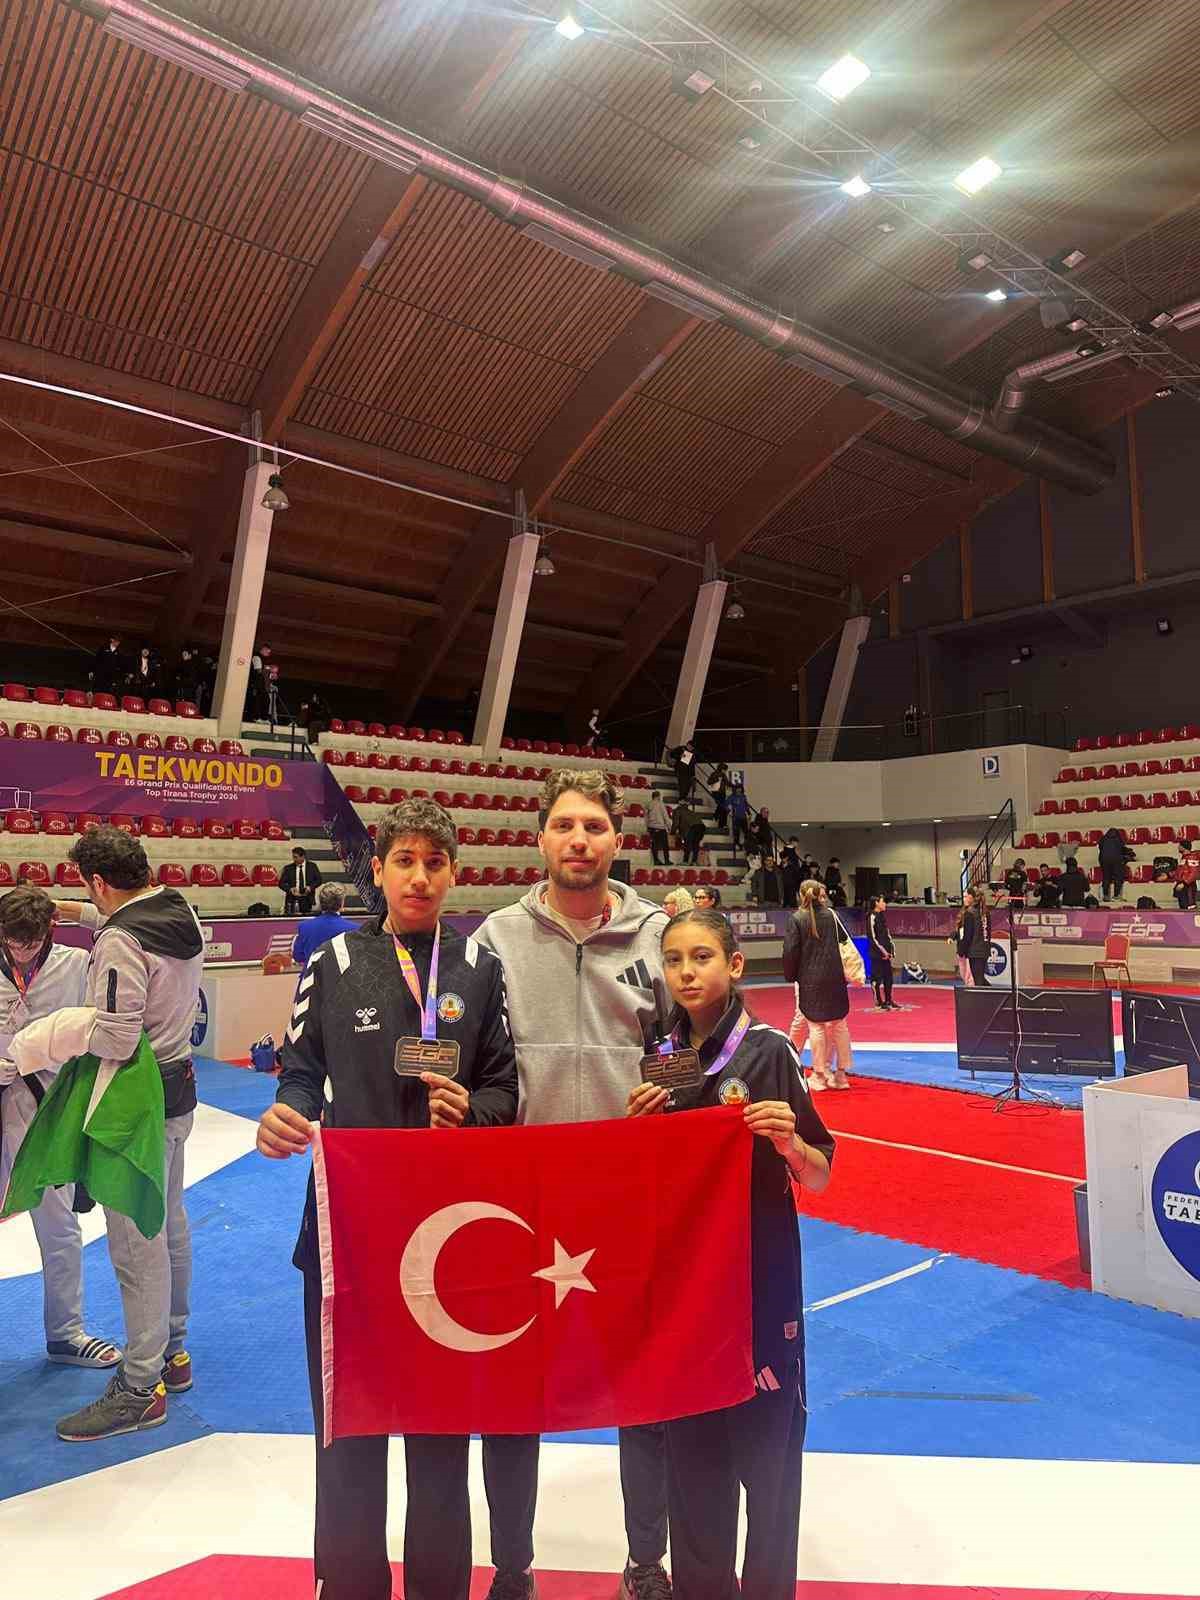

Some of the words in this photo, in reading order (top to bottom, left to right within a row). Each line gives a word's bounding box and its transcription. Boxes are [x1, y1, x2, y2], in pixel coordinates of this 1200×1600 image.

[95, 752, 282, 788] TAEKWONDO
[985, 757, 997, 774] D
[137, 780, 163, 788] Grand
[182, 782, 232, 791] Qualification
[233, 784, 256, 793] Event
[145, 789, 161, 797] Top
[163, 789, 188, 797] Tirana
[189, 791, 217, 800] Trophy
[218, 792, 239, 800] 2026
[1110, 923, 1166, 938] EGP
[354, 1022, 380, 1033] hummel
